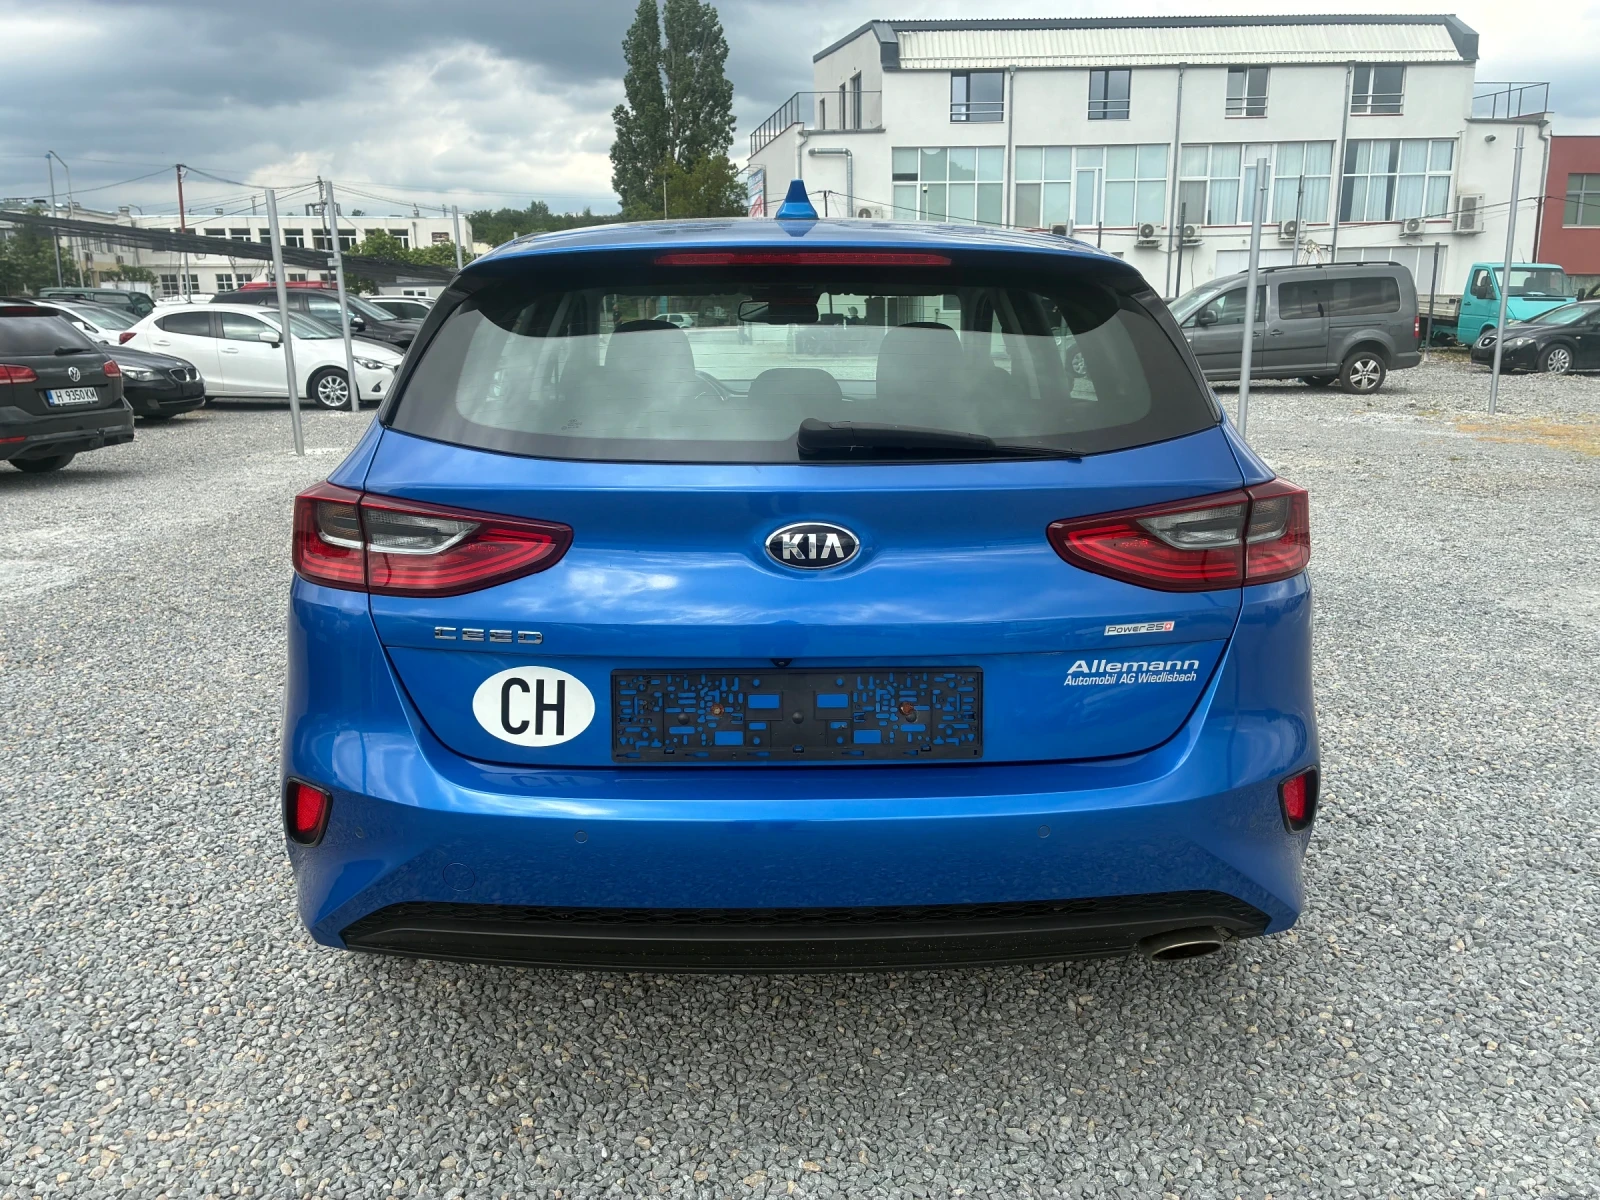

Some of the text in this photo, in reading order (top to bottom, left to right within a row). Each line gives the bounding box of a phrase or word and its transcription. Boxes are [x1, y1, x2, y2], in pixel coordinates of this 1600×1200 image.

[55, 390, 64, 403] H
[780, 532, 845, 560] KIA
[434, 626, 544, 645] CEED
[1066, 659, 1200, 674] Allemann
[1063, 671, 1197, 686] Automobil AG Wiedlisbach
[501, 677, 566, 736] CH
